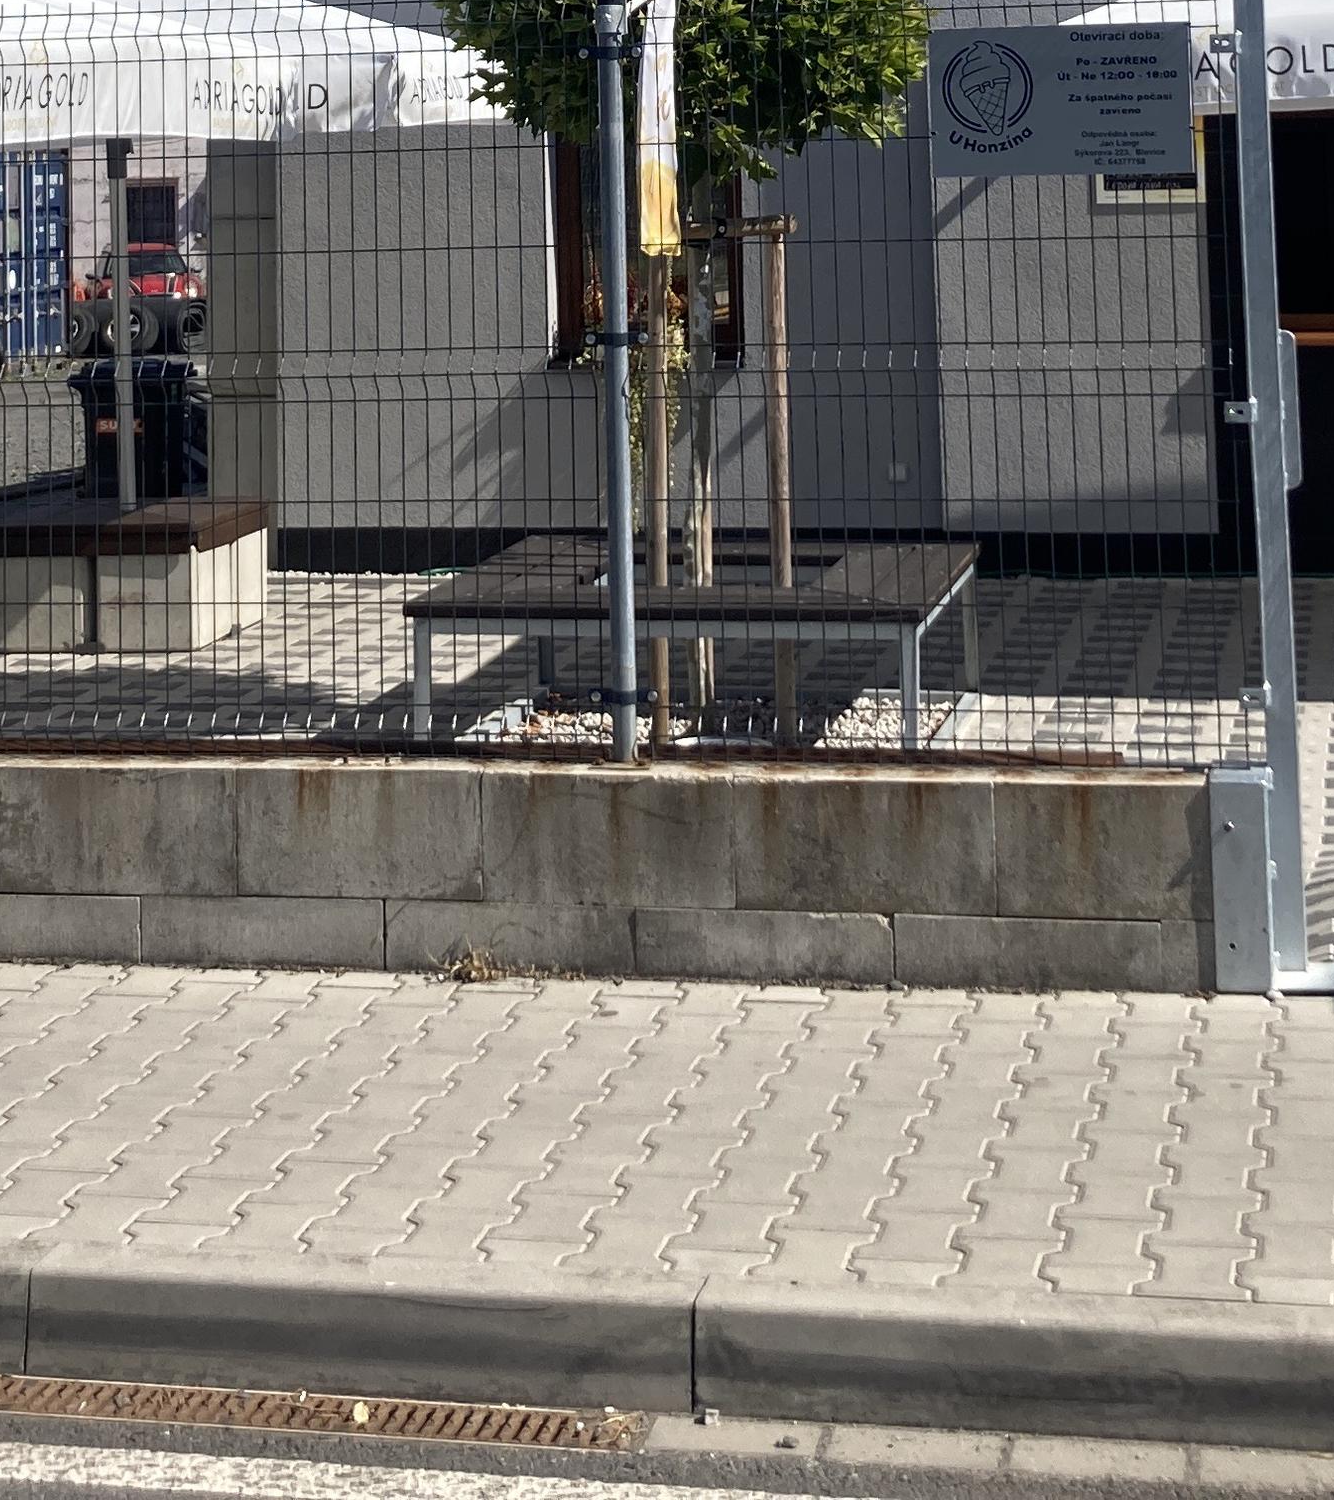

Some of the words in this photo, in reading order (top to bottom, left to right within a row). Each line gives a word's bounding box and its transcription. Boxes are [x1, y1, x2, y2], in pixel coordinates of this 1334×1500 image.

[1075, 57, 1091, 66] Po
[1100, 70, 1135, 80] 12:00
[949, 130, 964, 145] U
